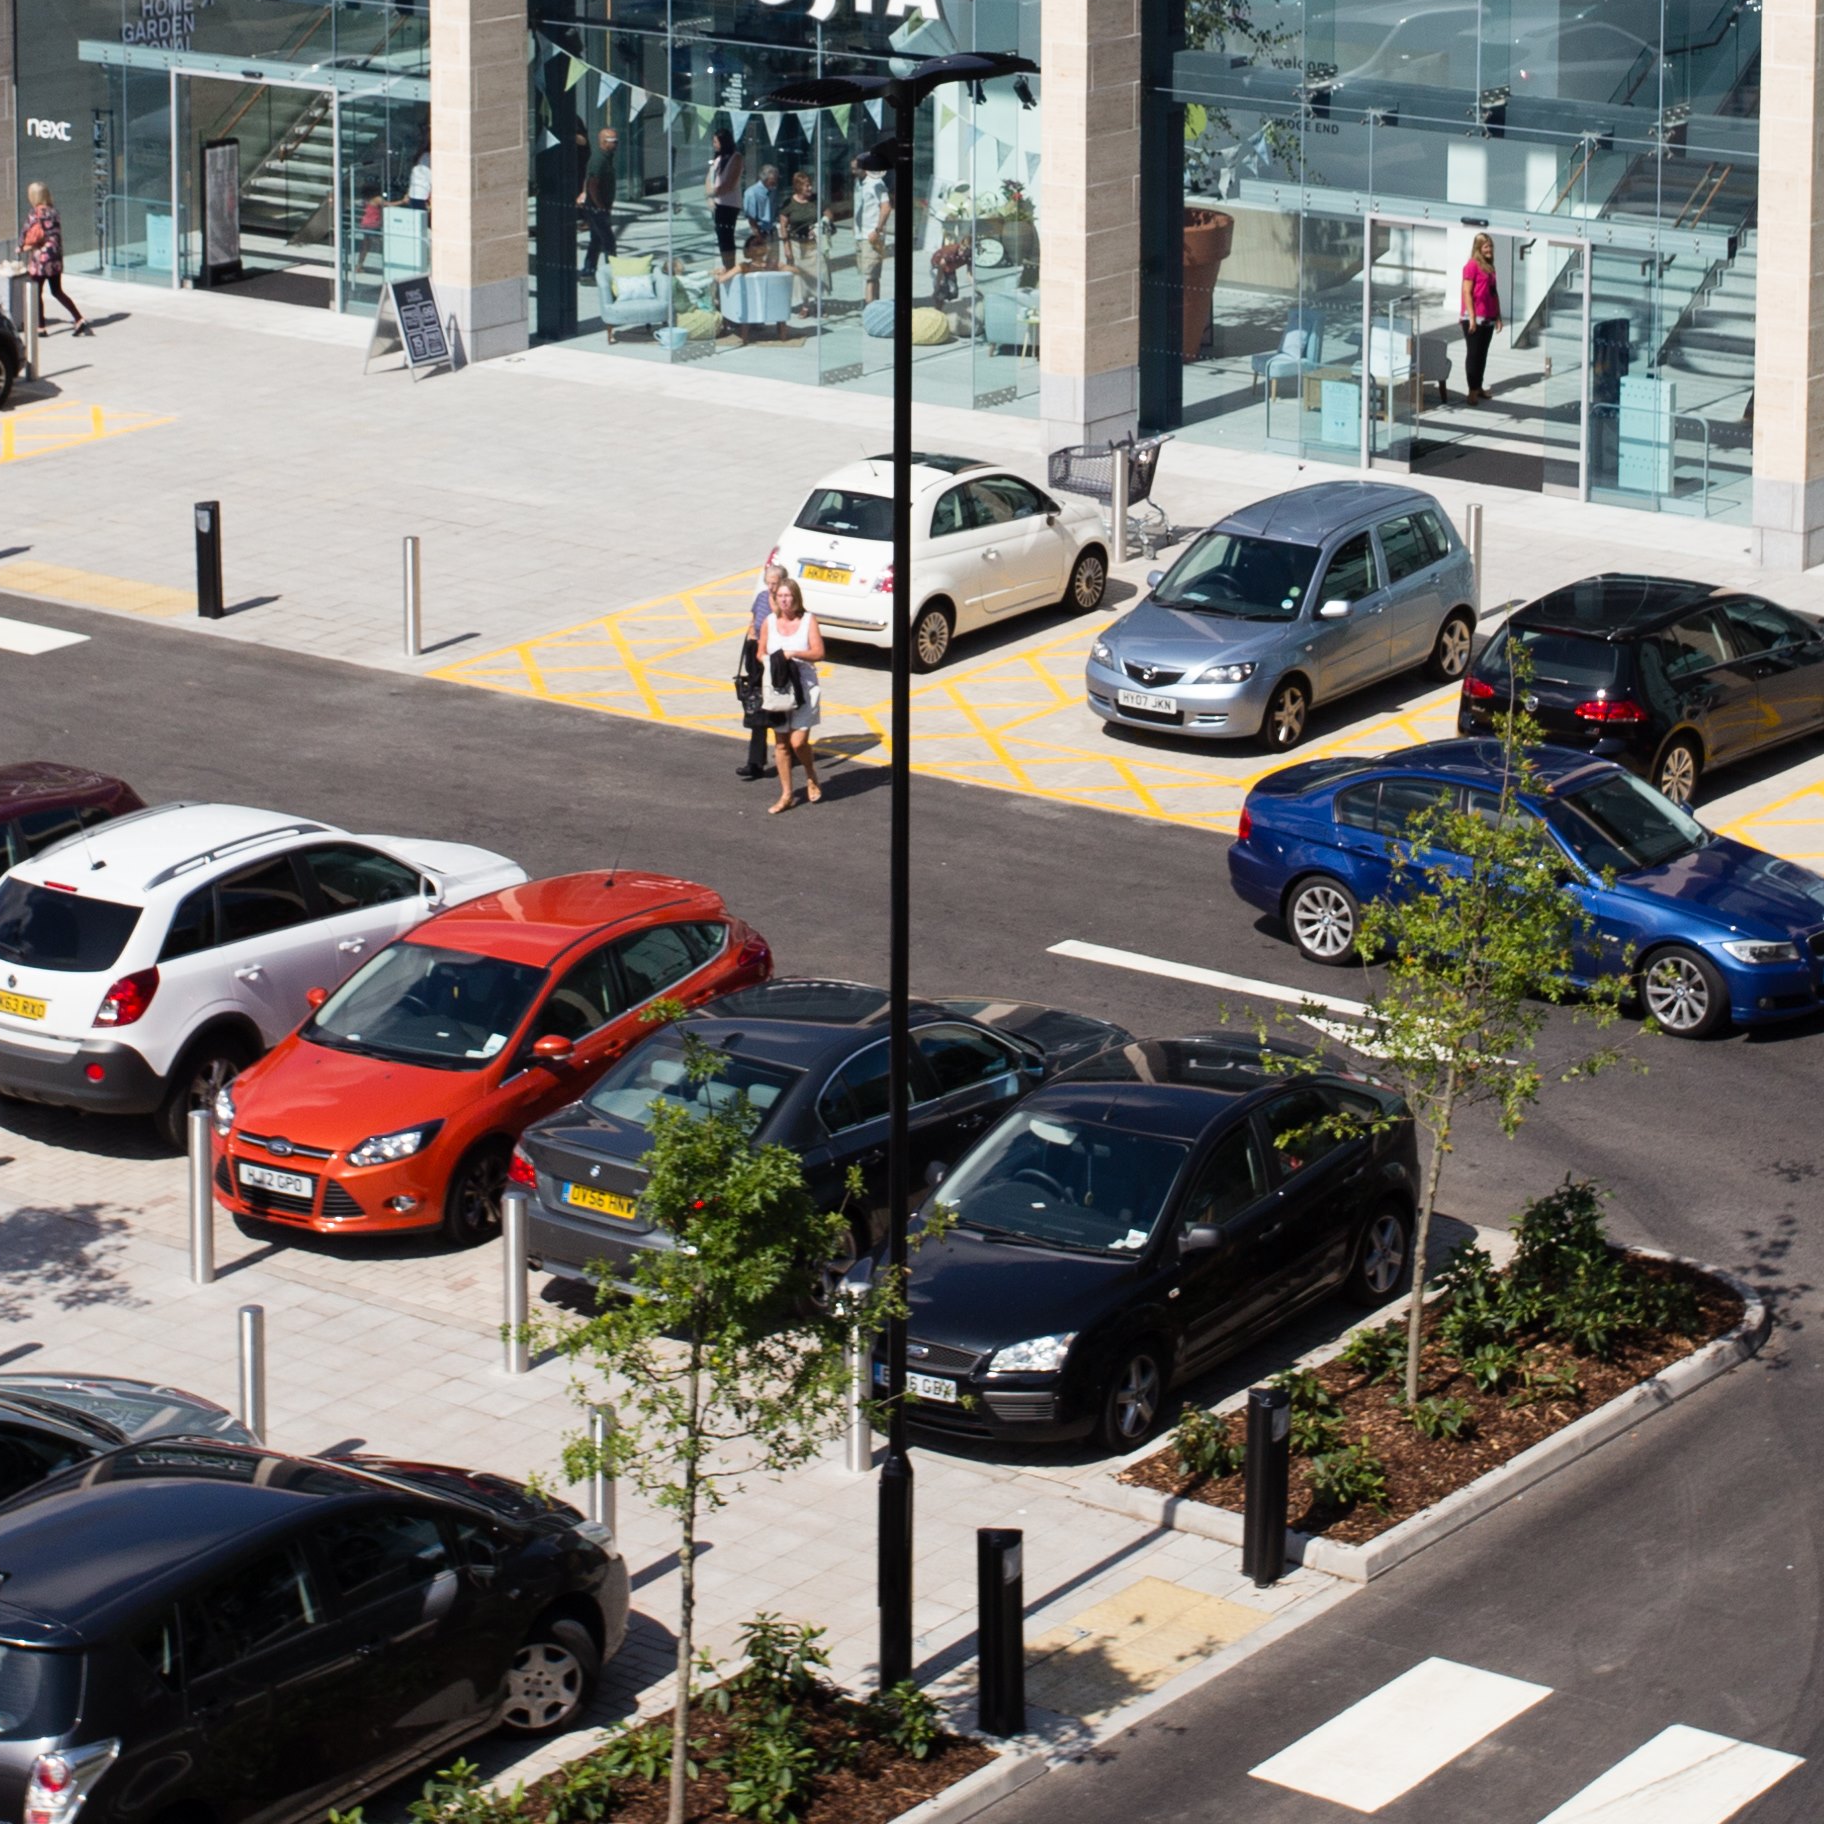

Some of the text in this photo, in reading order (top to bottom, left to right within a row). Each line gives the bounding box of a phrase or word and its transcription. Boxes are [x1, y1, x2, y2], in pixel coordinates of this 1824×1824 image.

[122, 14, 195, 43] GARDEN
[27, 117, 72, 142] next
[1315, 122, 1339, 135] END
[1123, 692, 1172, 710] HY07 JKN
